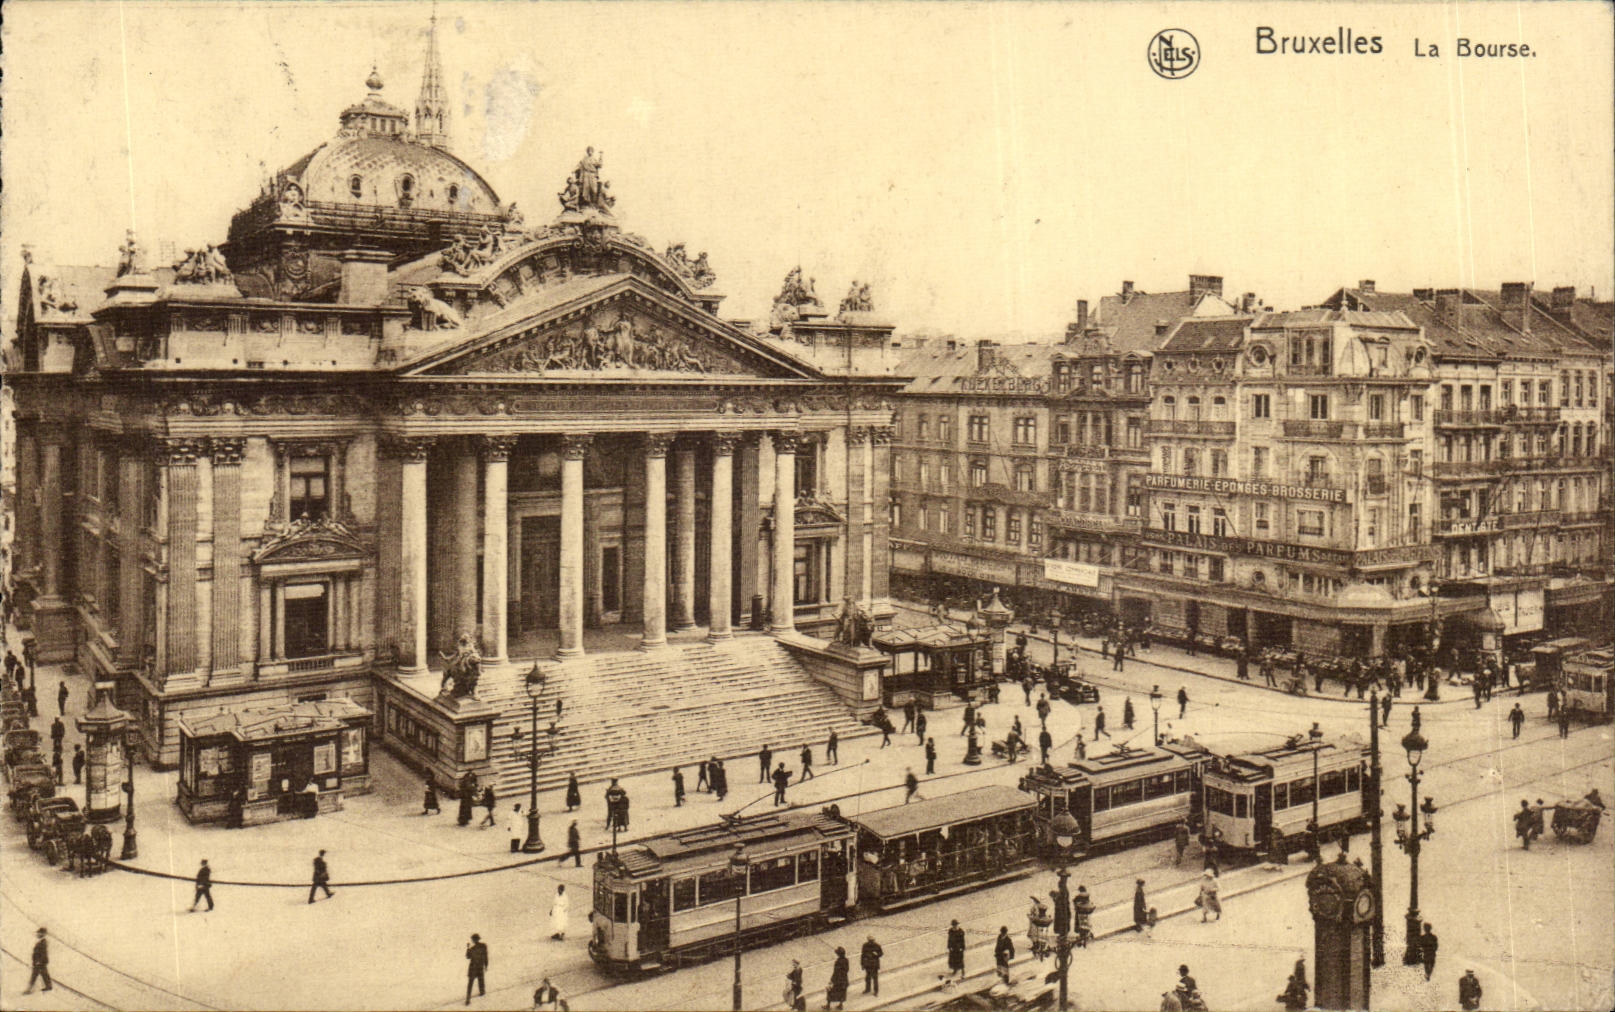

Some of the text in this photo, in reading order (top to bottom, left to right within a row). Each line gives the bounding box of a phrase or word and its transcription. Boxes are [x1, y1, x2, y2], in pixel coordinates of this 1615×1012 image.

[1451, 520, 1499, 535] DENTSTE
[1167, 532, 1217, 550] PALAIS
[1247, 541, 1321, 561] PARFUMS
